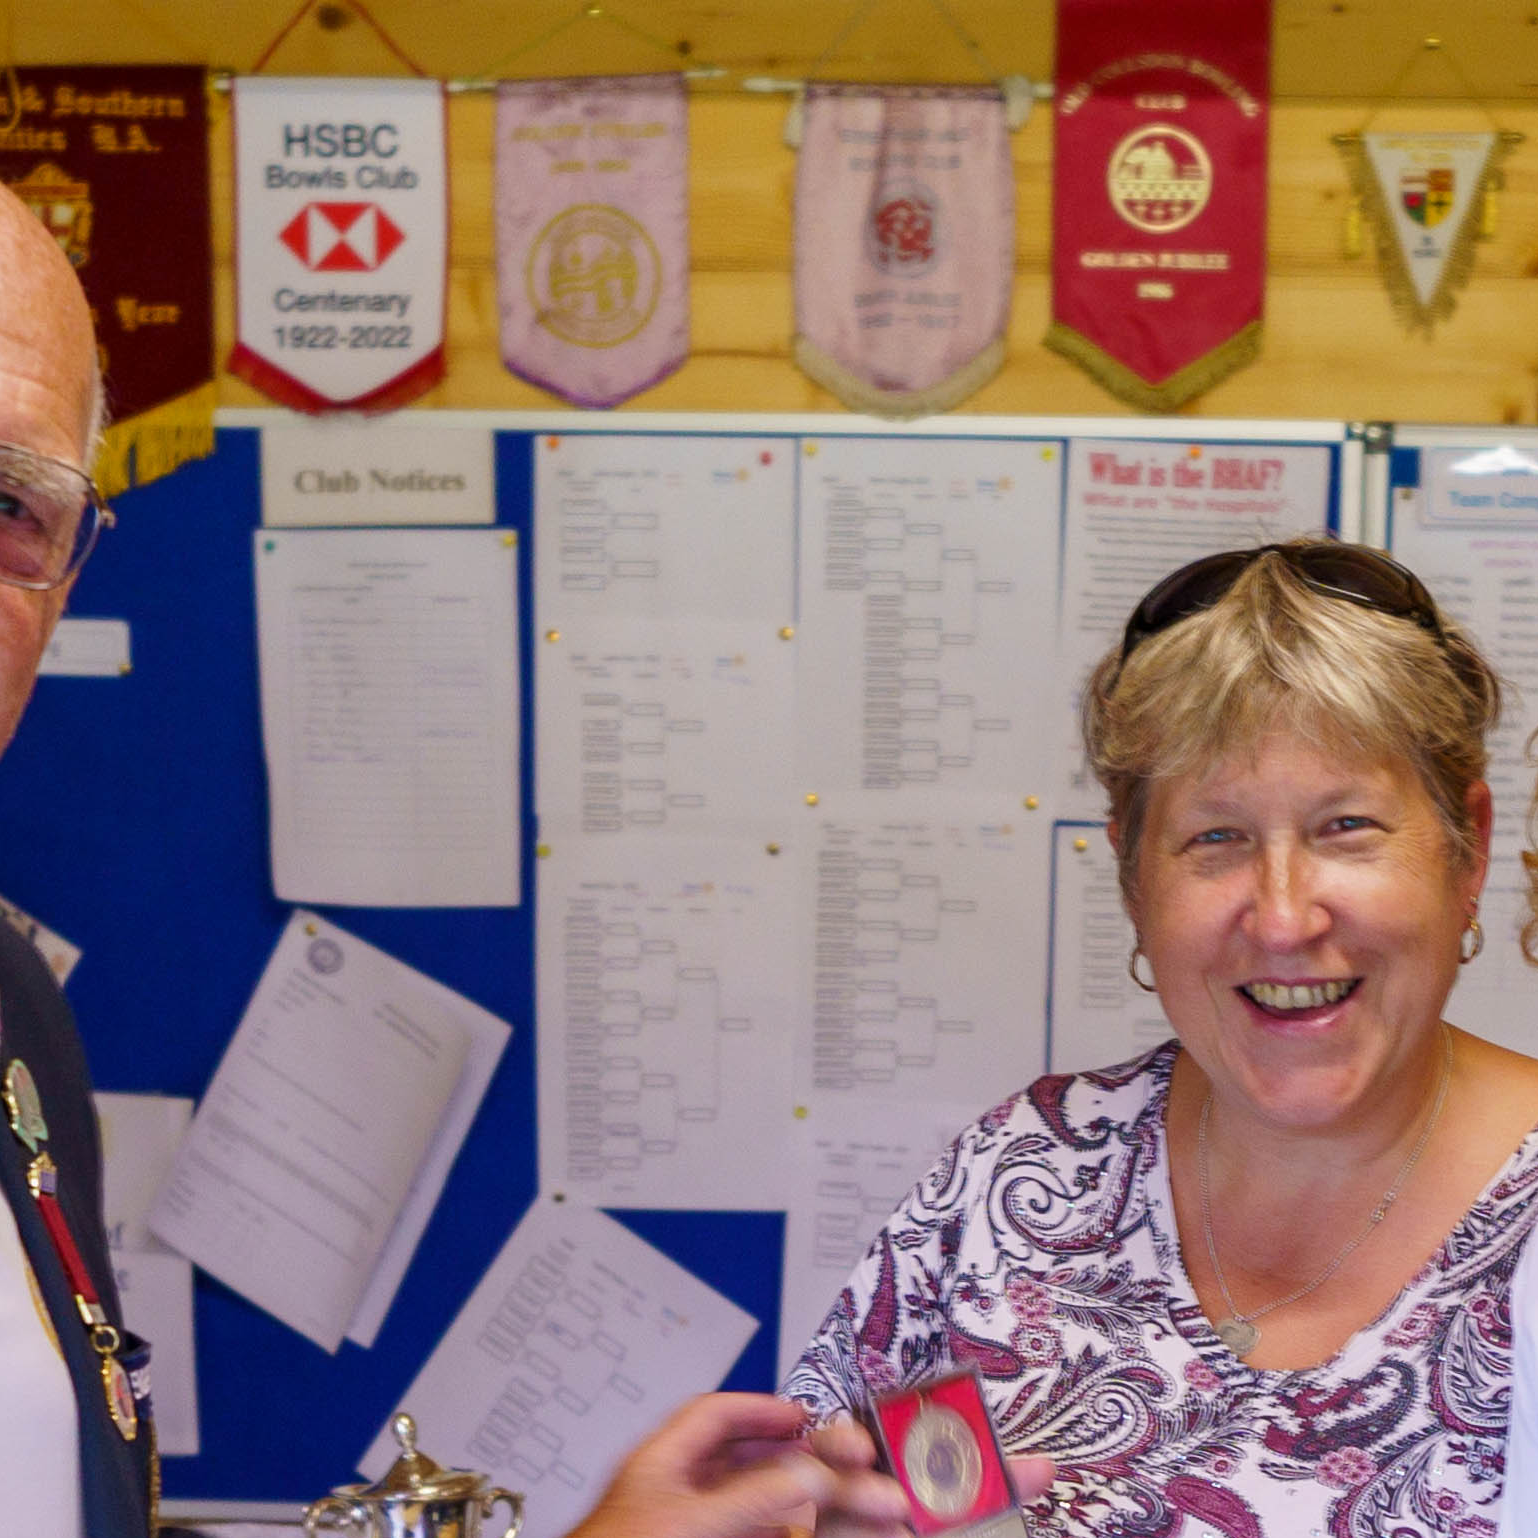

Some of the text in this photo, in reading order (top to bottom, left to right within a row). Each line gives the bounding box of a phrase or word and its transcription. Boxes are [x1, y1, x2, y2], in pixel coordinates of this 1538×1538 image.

[50, 82, 185, 118] Southern
[283, 123, 400, 158] HSBC
[265, 164, 418, 190] Bowls Club
[274, 287, 412, 318] Centenary
[273, 326, 412, 349] 1922-2022
[295, 468, 467, 494] Club Notices
[1089, 451, 1143, 486] What
[1147, 456, 1166, 487] is
[1173, 457, 1204, 488] the
